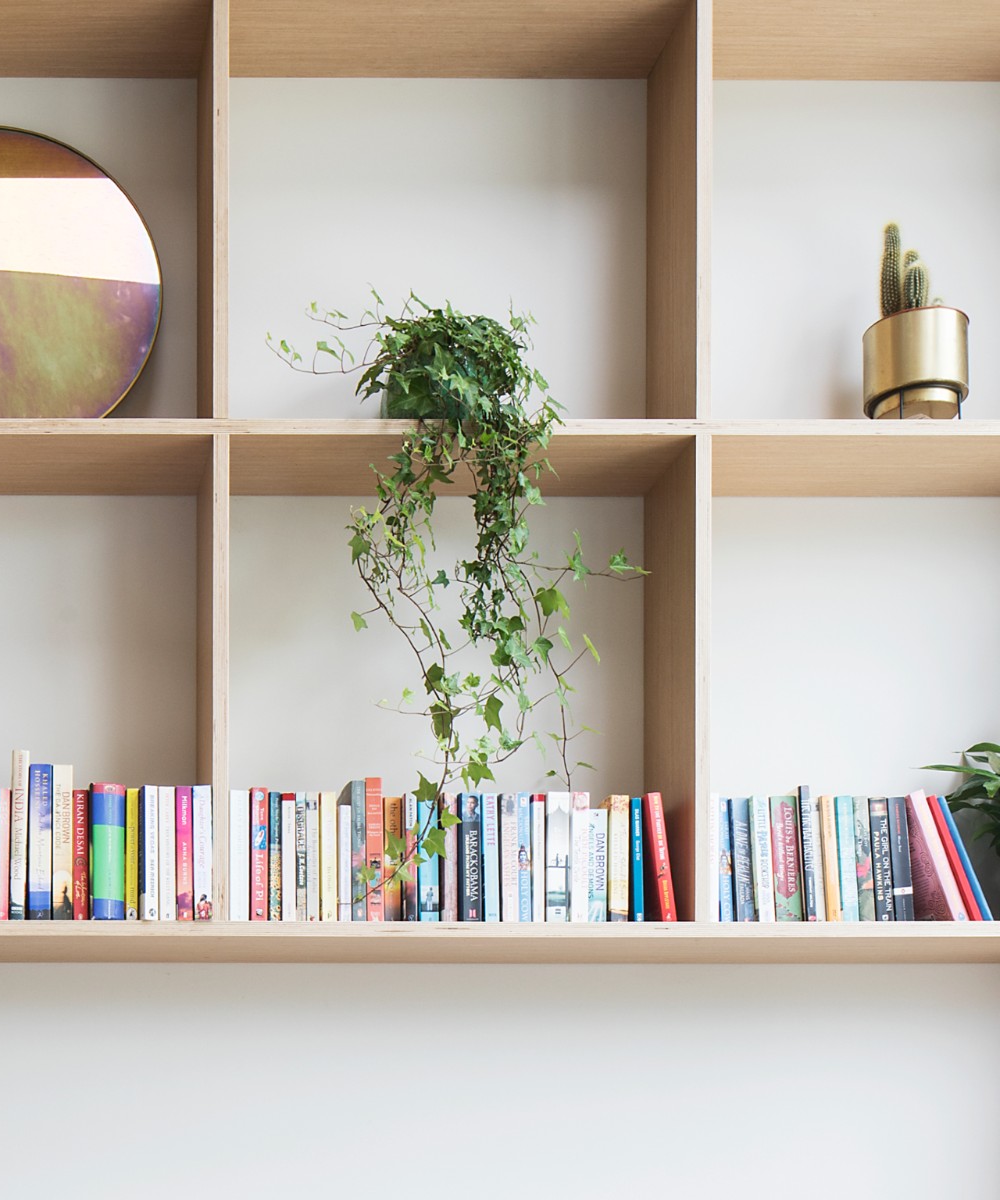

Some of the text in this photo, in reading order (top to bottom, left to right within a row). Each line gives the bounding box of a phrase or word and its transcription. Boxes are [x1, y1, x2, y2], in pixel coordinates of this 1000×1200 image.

[14, 788, 24, 822] INDIA
[55, 798, 61, 808] DA
[62, 792, 70, 843] DAN BROWN
[390, 803, 398, 817] the
[758, 809, 766, 828] LITTLE
[486, 796, 495, 846] KATHY LETTE
[735, 820, 748, 849] ALONE
[784, 807, 792, 834] LOUIS
[14, 828, 23, 880] Michael Wood
[470, 830, 478, 901] BARACK OBAMA
[596, 833, 605, 891] DAN BROWN
[737, 855, 750, 883] BERLIN
[883, 857, 889, 869] ON
[256, 854, 264, 900] Life of Pi
[876, 863, 884, 901] HAWKINS
[521, 898, 529, 921] COW
